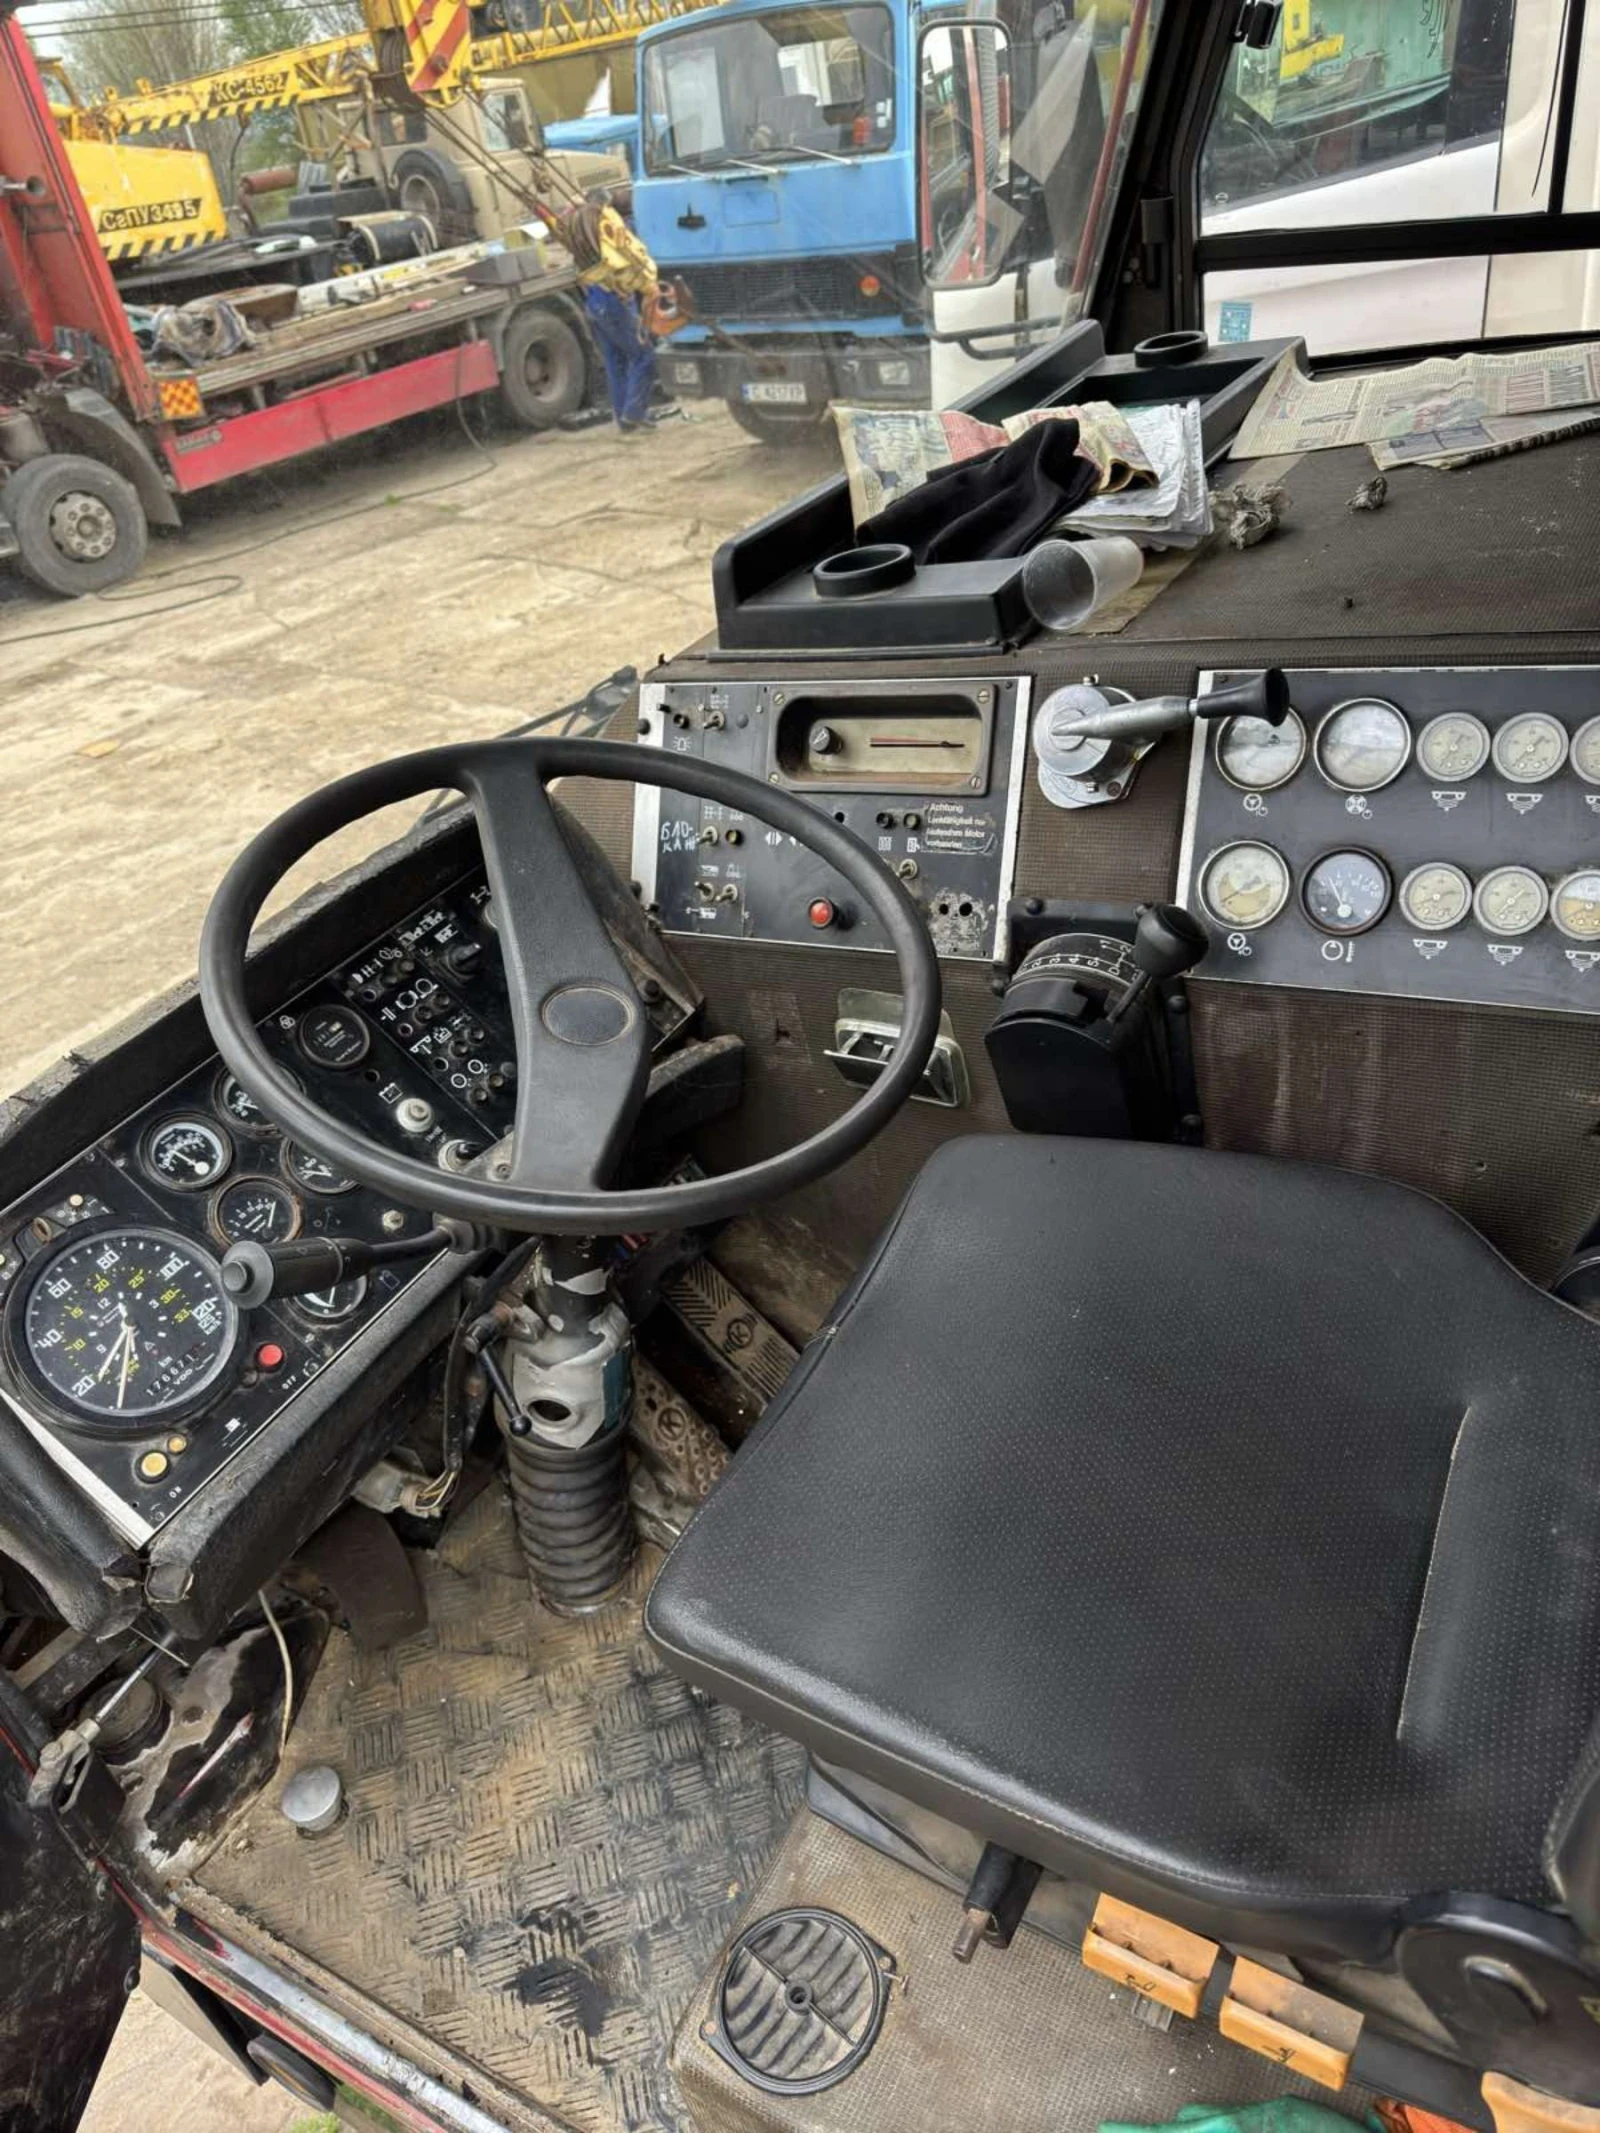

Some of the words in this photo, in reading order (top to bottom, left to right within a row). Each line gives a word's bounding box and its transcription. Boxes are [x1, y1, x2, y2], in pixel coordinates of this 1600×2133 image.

[96, 1249, 120, 1270] 80
[160, 1256, 185, 1281] 100
[48, 1277, 72, 1298] 60
[93, 1278, 110, 1292] 20
[128, 1274, 145, 1289] 25
[97, 1297, 112, 1310] 12
[148, 1298, 160, 1310] 3
[160, 1289, 177, 1305] 30
[70, 1306, 84, 1319] 15
[191, 1299, 217, 1321] 120
[37, 1328, 63, 1348] 40
[72, 1338, 87, 1351] 10
[71, 1375, 97, 1397] 20
